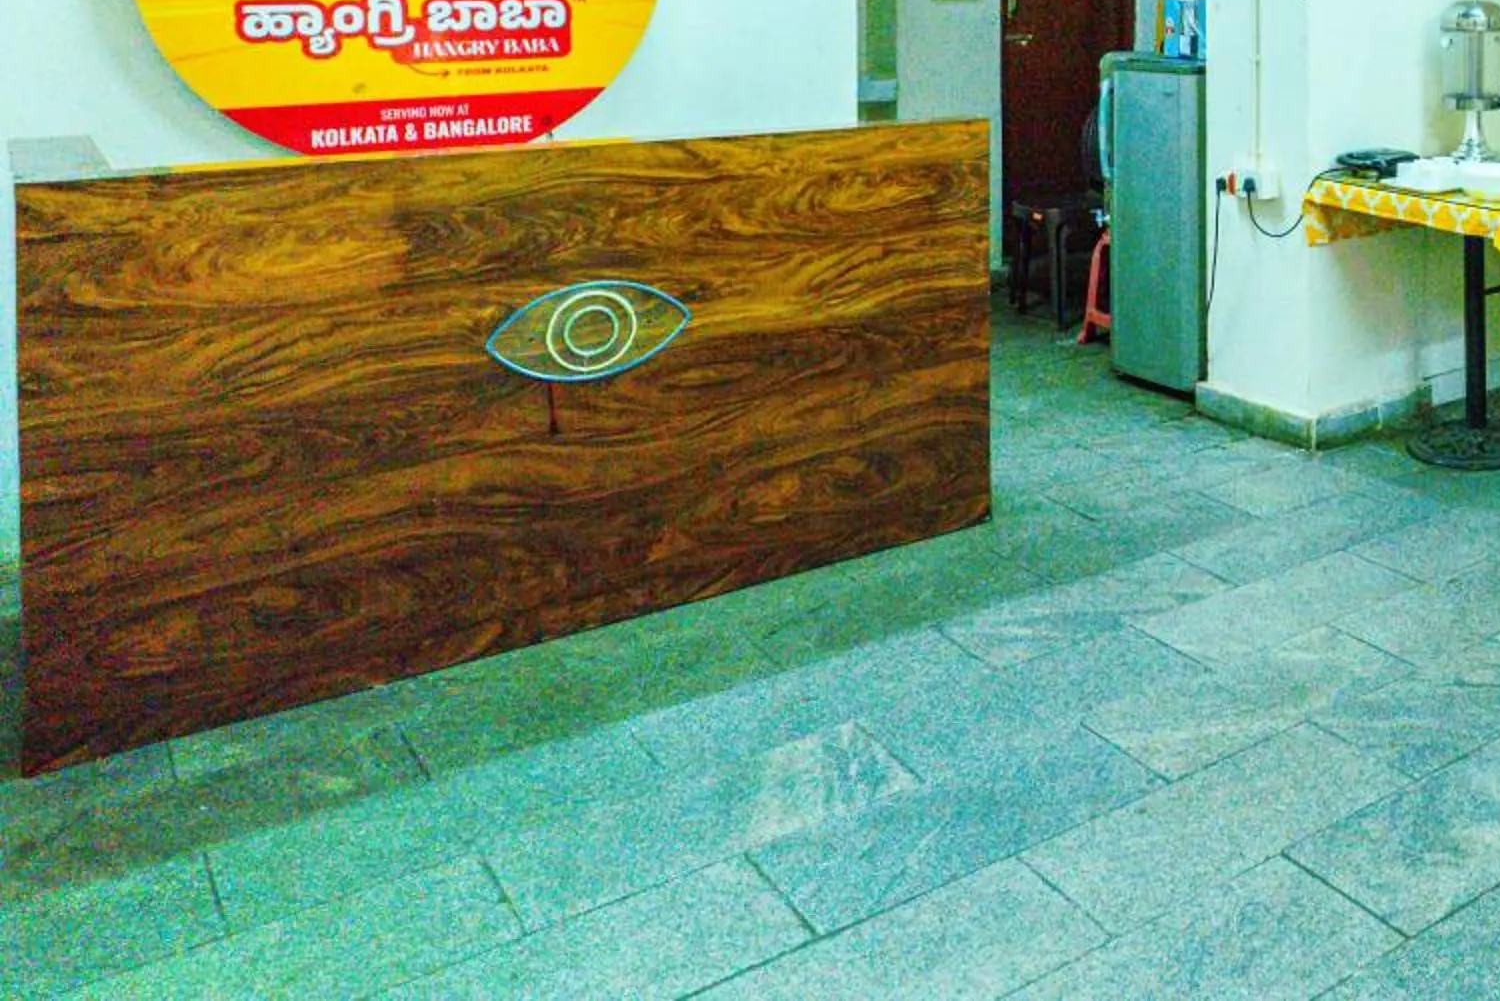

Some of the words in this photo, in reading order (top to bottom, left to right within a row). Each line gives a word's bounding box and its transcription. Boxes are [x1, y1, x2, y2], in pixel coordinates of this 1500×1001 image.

[412, 38, 500, 59] HANGRY
[502, 36, 561, 54] BABA
[380, 106, 427, 121] SERVING
[429, 104, 454, 118] NOW
[456, 103, 470, 116] AT
[311, 124, 399, 149] KOLKATA
[404, 122, 418, 141] &
[423, 114, 533, 141] BANGALORE
